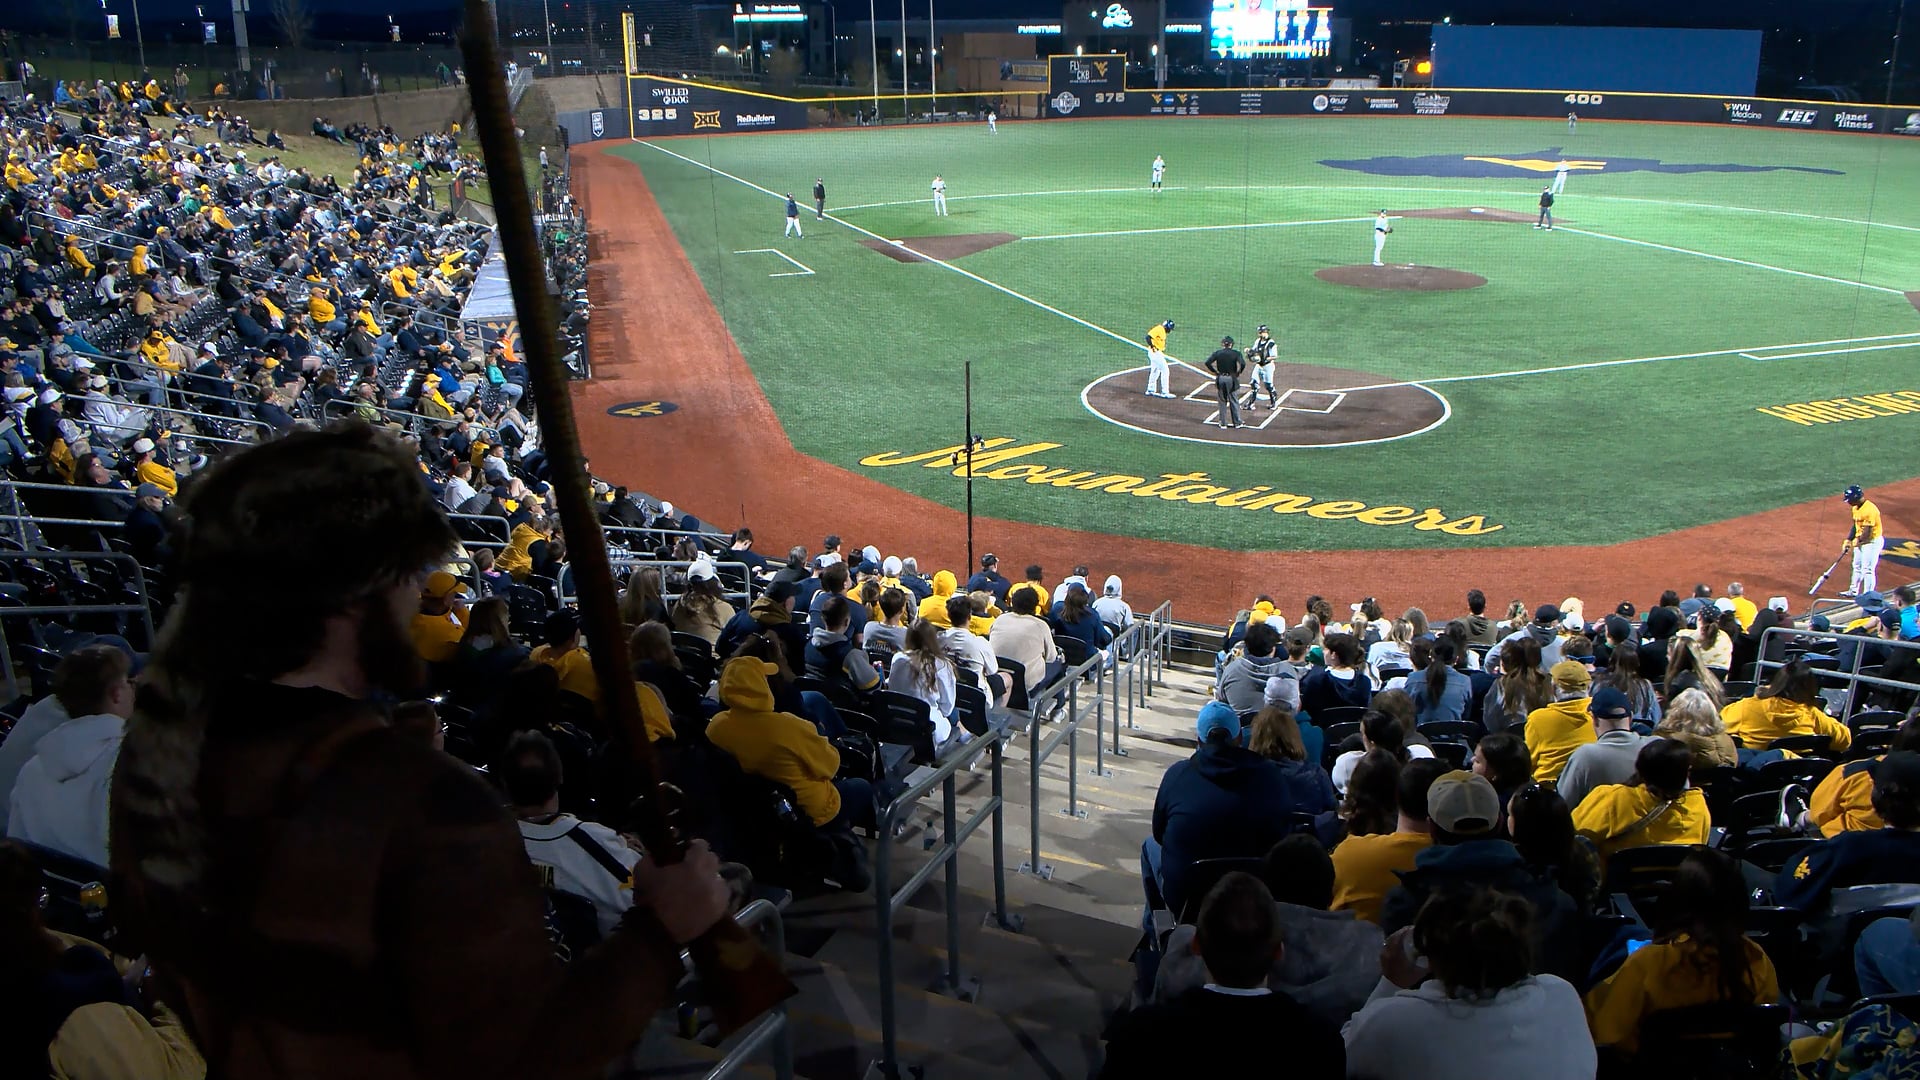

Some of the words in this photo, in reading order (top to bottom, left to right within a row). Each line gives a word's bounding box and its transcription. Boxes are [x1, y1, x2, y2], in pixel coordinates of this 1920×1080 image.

[652, 88, 689, 97] SWILLED
[1095, 92, 1125, 103] 375
[671, 96, 689, 104] DOG
[1564, 93, 1603, 105] 400
[1731, 103, 1751, 111] WVU
[638, 108, 677, 120] 325
[1731, 111, 1762, 120] Medicine
[1834, 111, 1867, 123] planet
[1838, 120, 1874, 129] fitness
[859, 437, 1504, 537] Mountaineers
